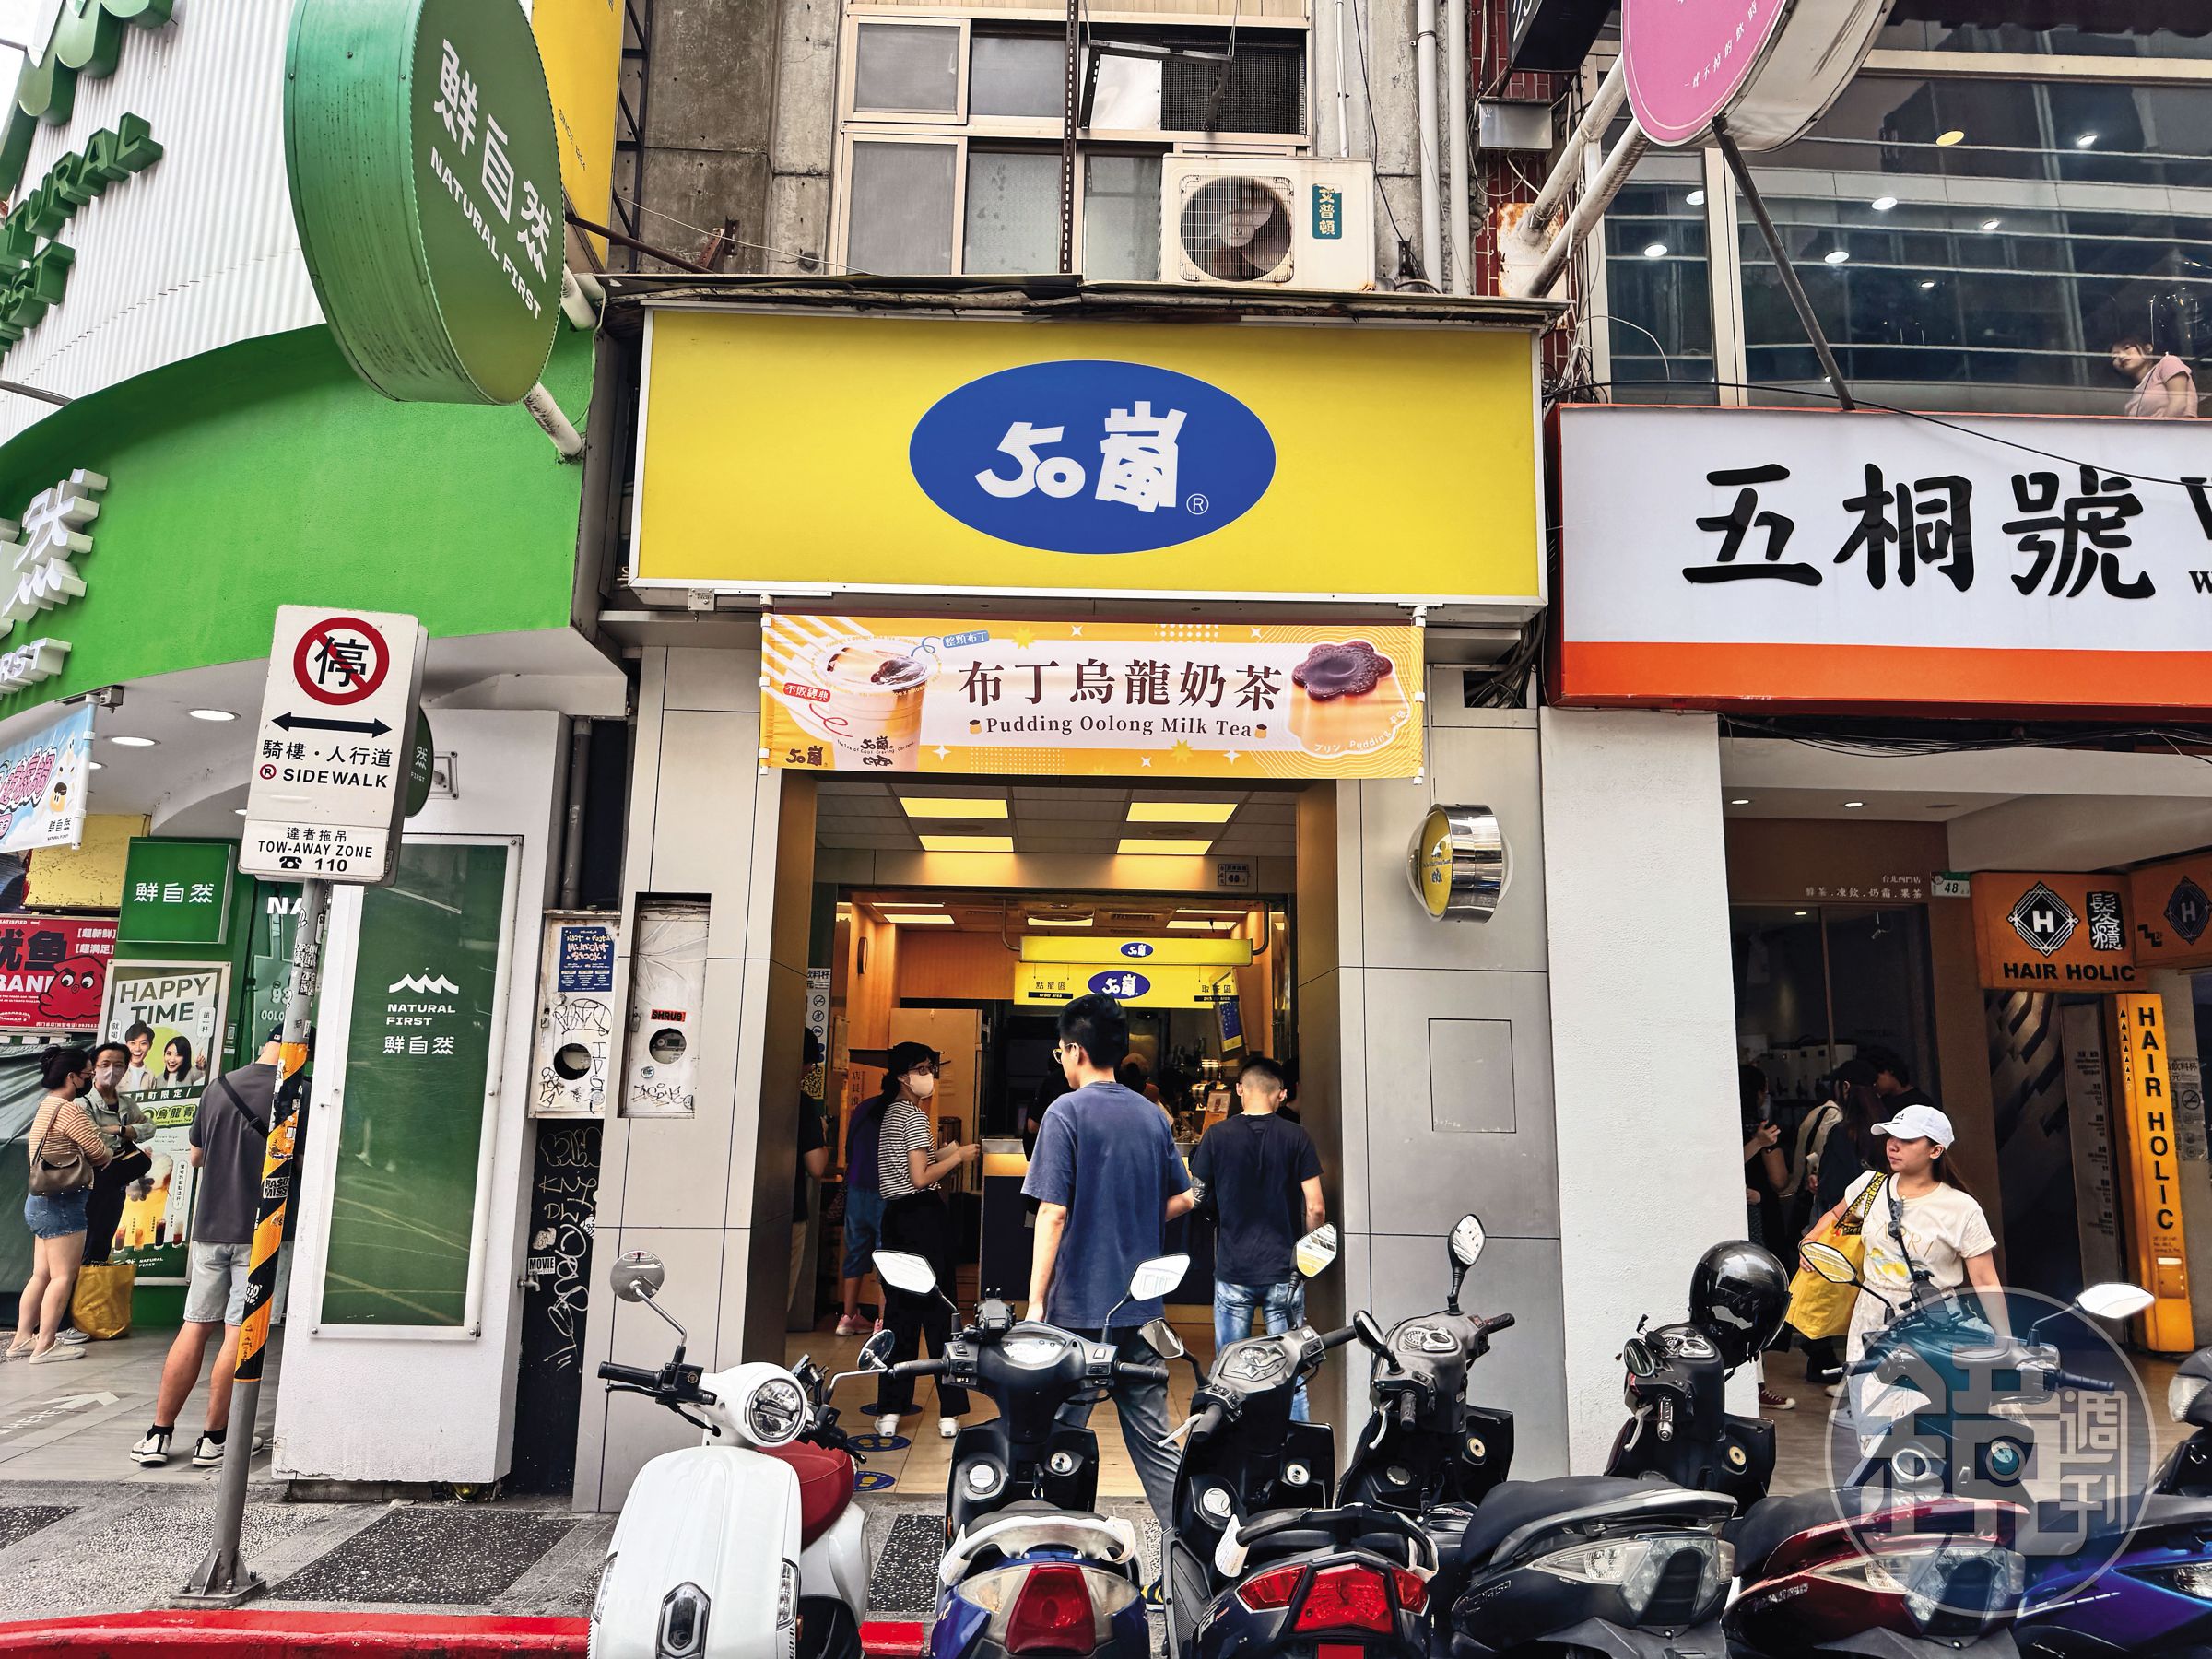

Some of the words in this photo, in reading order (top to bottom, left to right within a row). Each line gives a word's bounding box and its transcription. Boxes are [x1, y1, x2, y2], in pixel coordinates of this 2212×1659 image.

[434, 39, 552, 282] 鮮自然
[430, 147, 500, 261] NATURAL
[502, 253, 542, 320] FIRST
[975, 401, 1187, 512] 50嵐
[1682, 463, 2156, 599] 五桐號
[946, 632, 987, 646] 整顆布丁
[314, 636, 369, 687] 停
[785, 685, 829, 700] 不敗經典
[959, 658, 1282, 711] 布丁烏龍奶茶
[986, 716, 1072, 735] Pudding
[1080, 715, 1153, 735] Oolong
[1162, 717, 1207, 735] Milk
[1216, 721, 1251, 736] Tea
[860, 735, 888, 750] 50嵐
[1349, 730, 1391, 749] Pudding
[786, 746, 823, 766] 50嵐
[283, 768, 388, 788] SIDEWALK
[286, 827, 347, 842] 違者拖吊
[258, 841, 331, 856] TOW-AWAY
[336, 844, 372, 858] ZONE
[314, 858, 347, 872] 110
[135, 882, 215, 904] 鮮自然
[1945, 883, 1958, 894] 48
[2032, 910, 2054, 933] H
[2181, 900, 2196, 923] H
[1127, 944, 1146, 957] 50嵐
[2003, 962, 2058, 980] HAIR
[2066, 964, 2136, 982] HOLIC
[120, 977, 211, 1004] HAPPY
[1102, 973, 1138, 997] 50嵐
[130, 1002, 195, 1025] TIME
[260, 1009, 285, 1021] OOLO
[387, 1004, 456, 1013] NATURAL
[386, 1017, 433, 1026] FIRST
[382, 1035, 455, 1055] 鮮自然
[2138, 1006, 2162, 1098] HAIR
[2148, 1111, 2174, 1230] HOLIC
[529, 1257, 555, 1269] MOVIE
